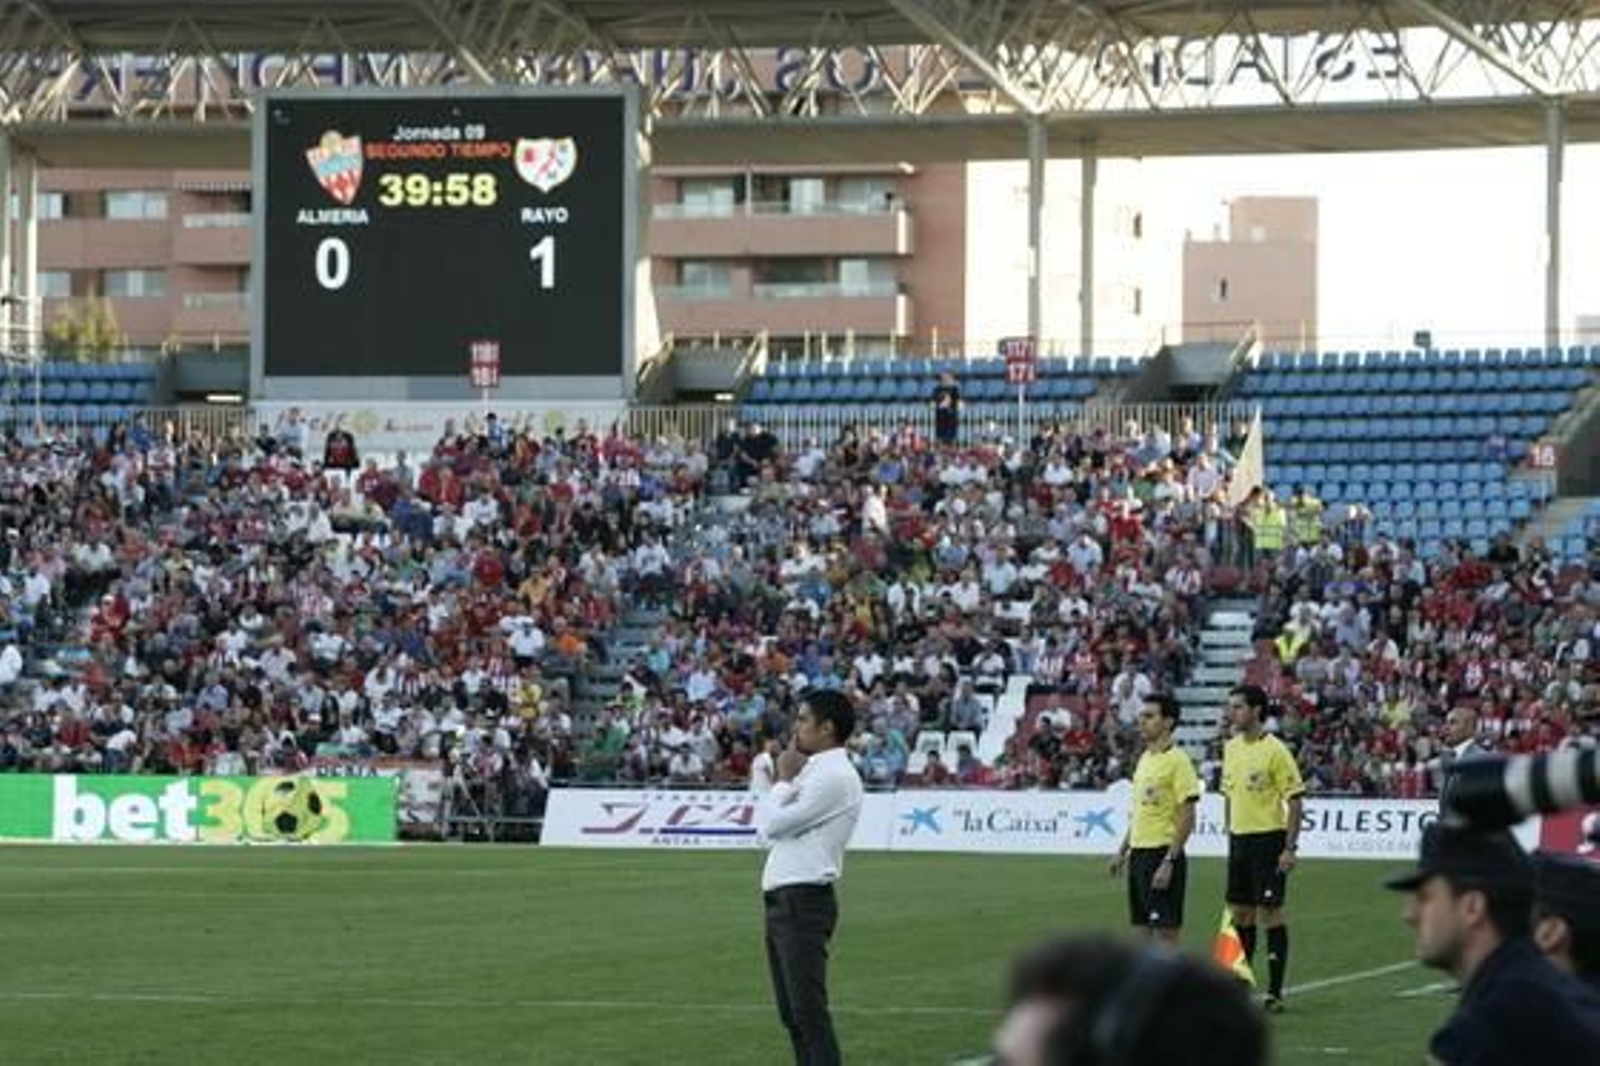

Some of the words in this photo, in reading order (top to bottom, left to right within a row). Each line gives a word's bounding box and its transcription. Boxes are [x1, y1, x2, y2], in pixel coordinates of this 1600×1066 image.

[392, 125, 461, 141] Jornada
[365, 142, 446, 159] SEGUNDO
[450, 141, 512, 158] TIEMPO
[378, 172, 498, 207] 39:58
[520, 207, 569, 225] RAYO
[314, 236, 351, 290] 0
[529, 234, 555, 289] 1
